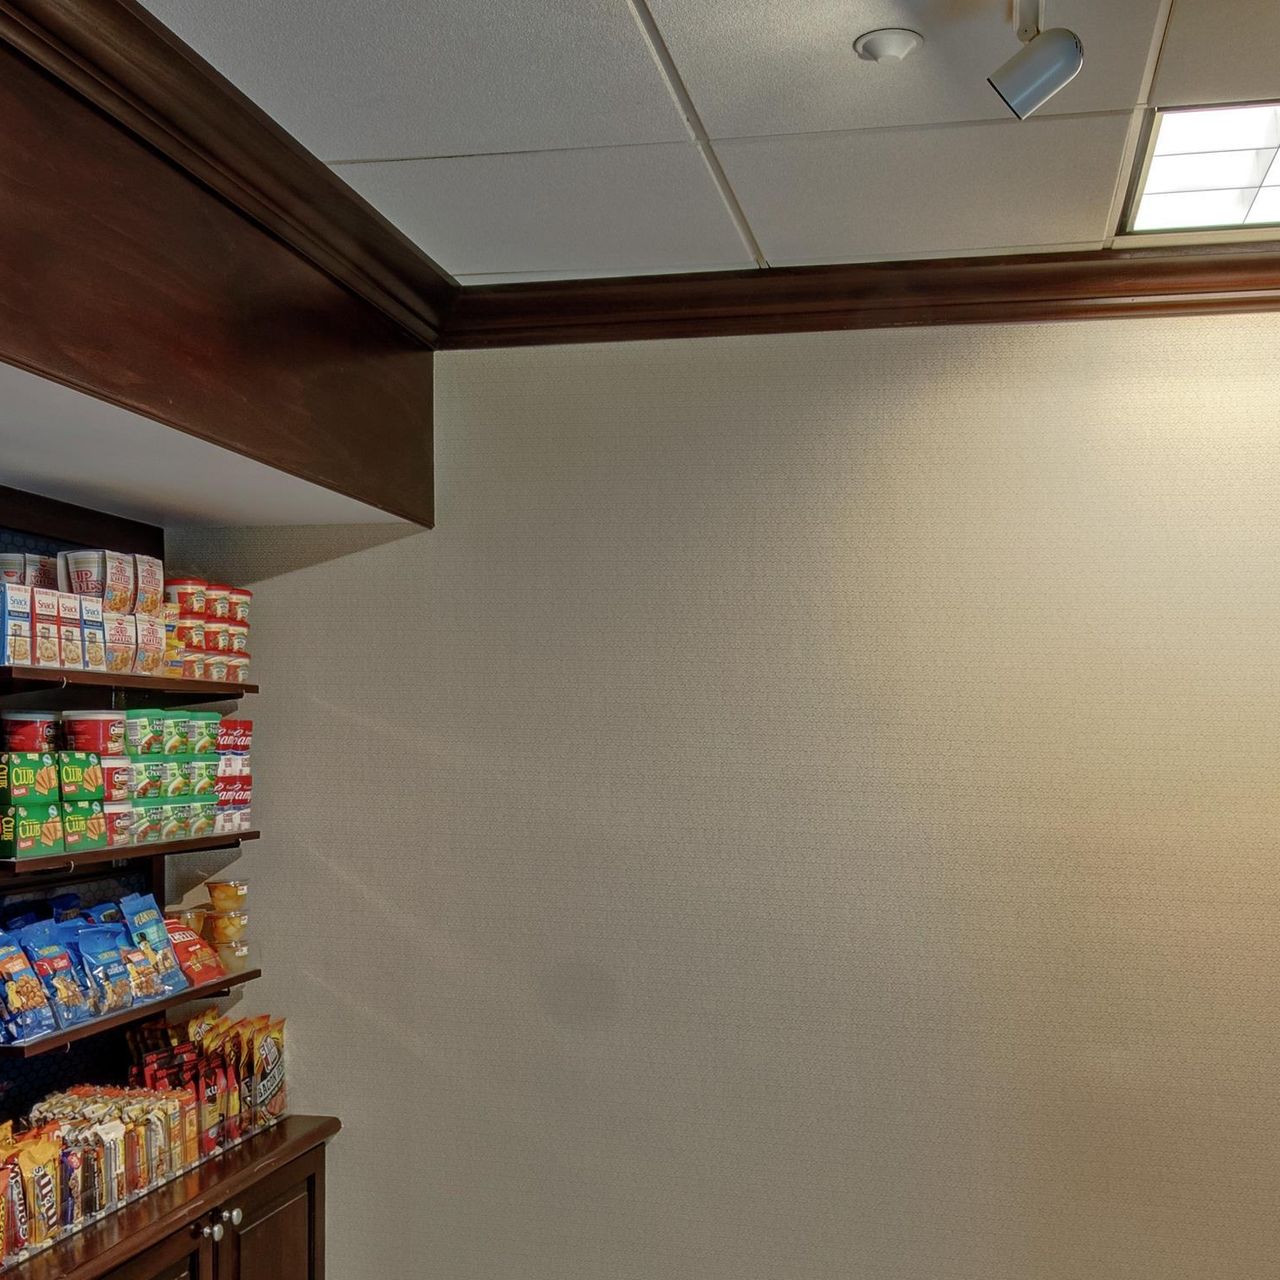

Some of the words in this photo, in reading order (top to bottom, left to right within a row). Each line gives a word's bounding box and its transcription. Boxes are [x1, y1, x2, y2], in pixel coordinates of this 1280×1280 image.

[10, 595, 28, 606] Snack
[37, 598, 56, 610] Snack
[61, 602, 78, 614] Snack
[85, 606, 100, 617] Snack
[13, 768, 34, 785] CLUB
[63, 766, 82, 783] CLUB
[19, 821, 40, 838] CLUB
